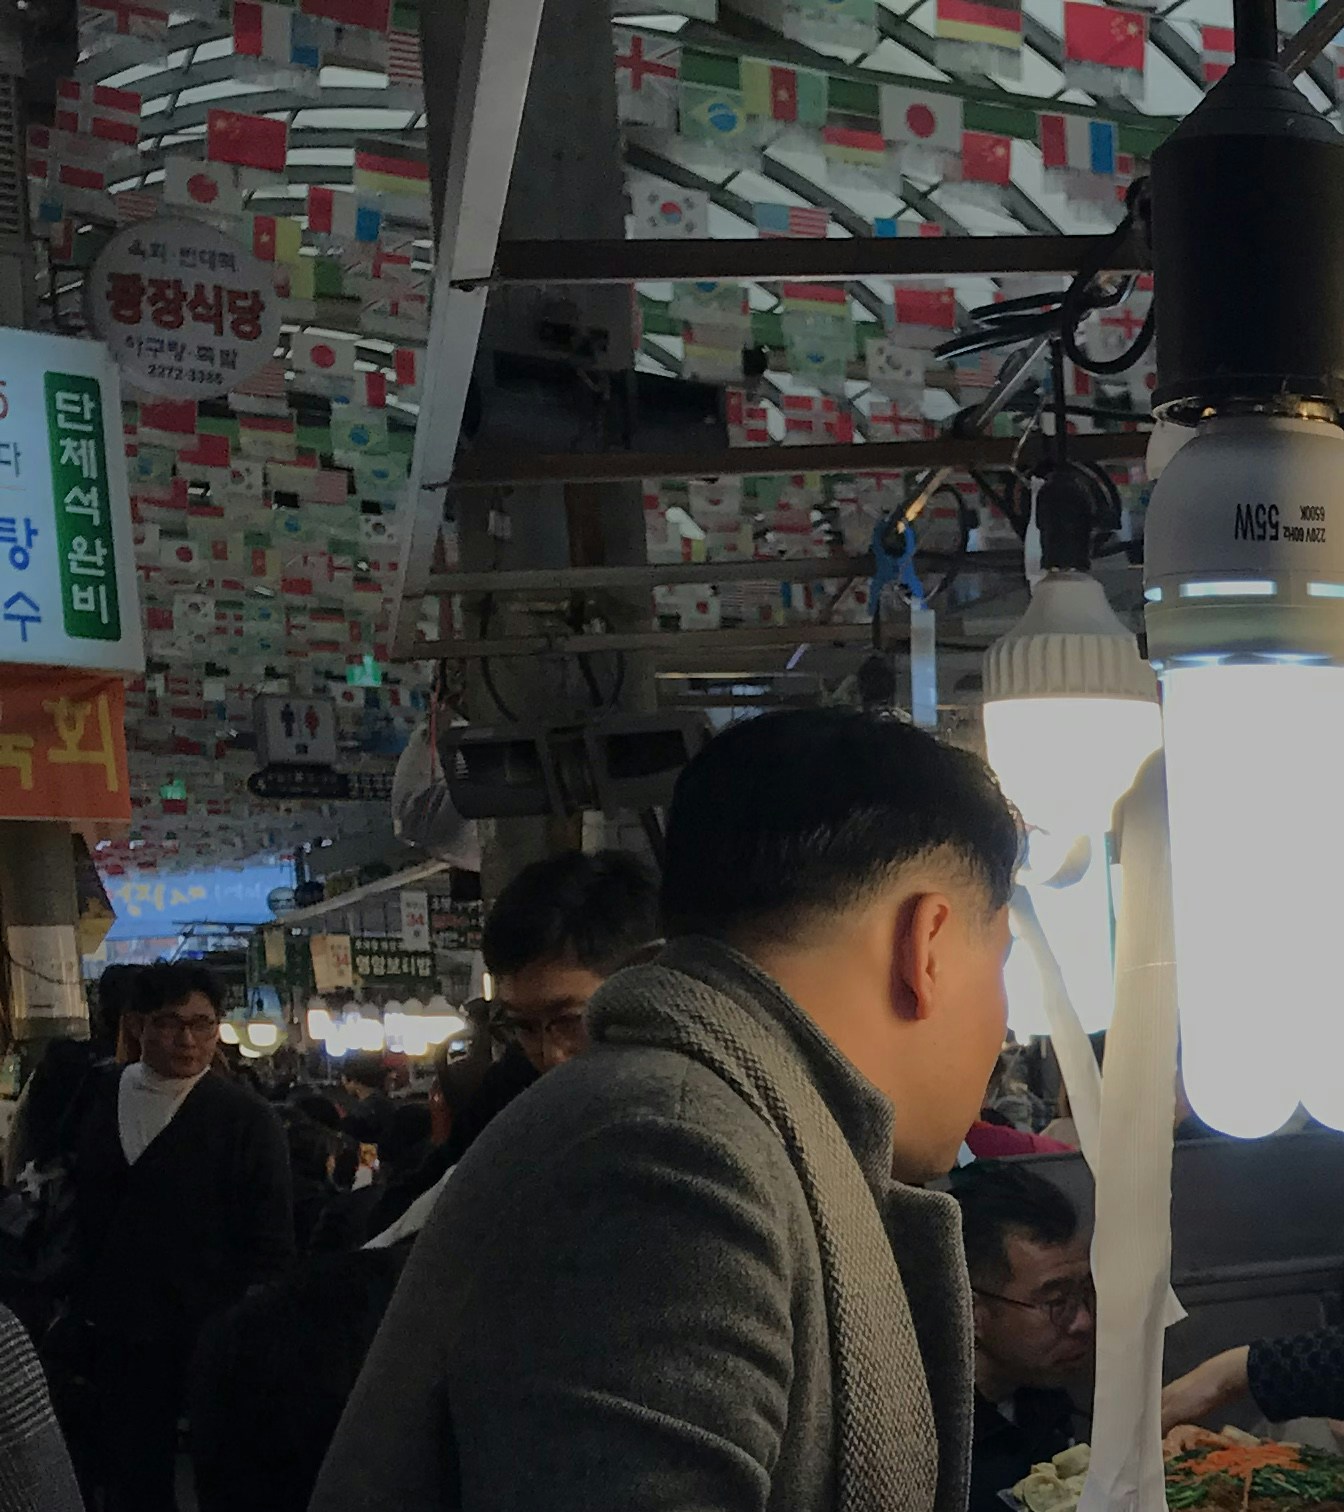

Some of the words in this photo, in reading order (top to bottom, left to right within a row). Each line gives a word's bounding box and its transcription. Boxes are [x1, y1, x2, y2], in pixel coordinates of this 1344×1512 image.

[106, 272, 265, 341] 광장식당
[1235, 503, 1279, 541] 55W
[1299, 504, 1325, 521] 6500K
